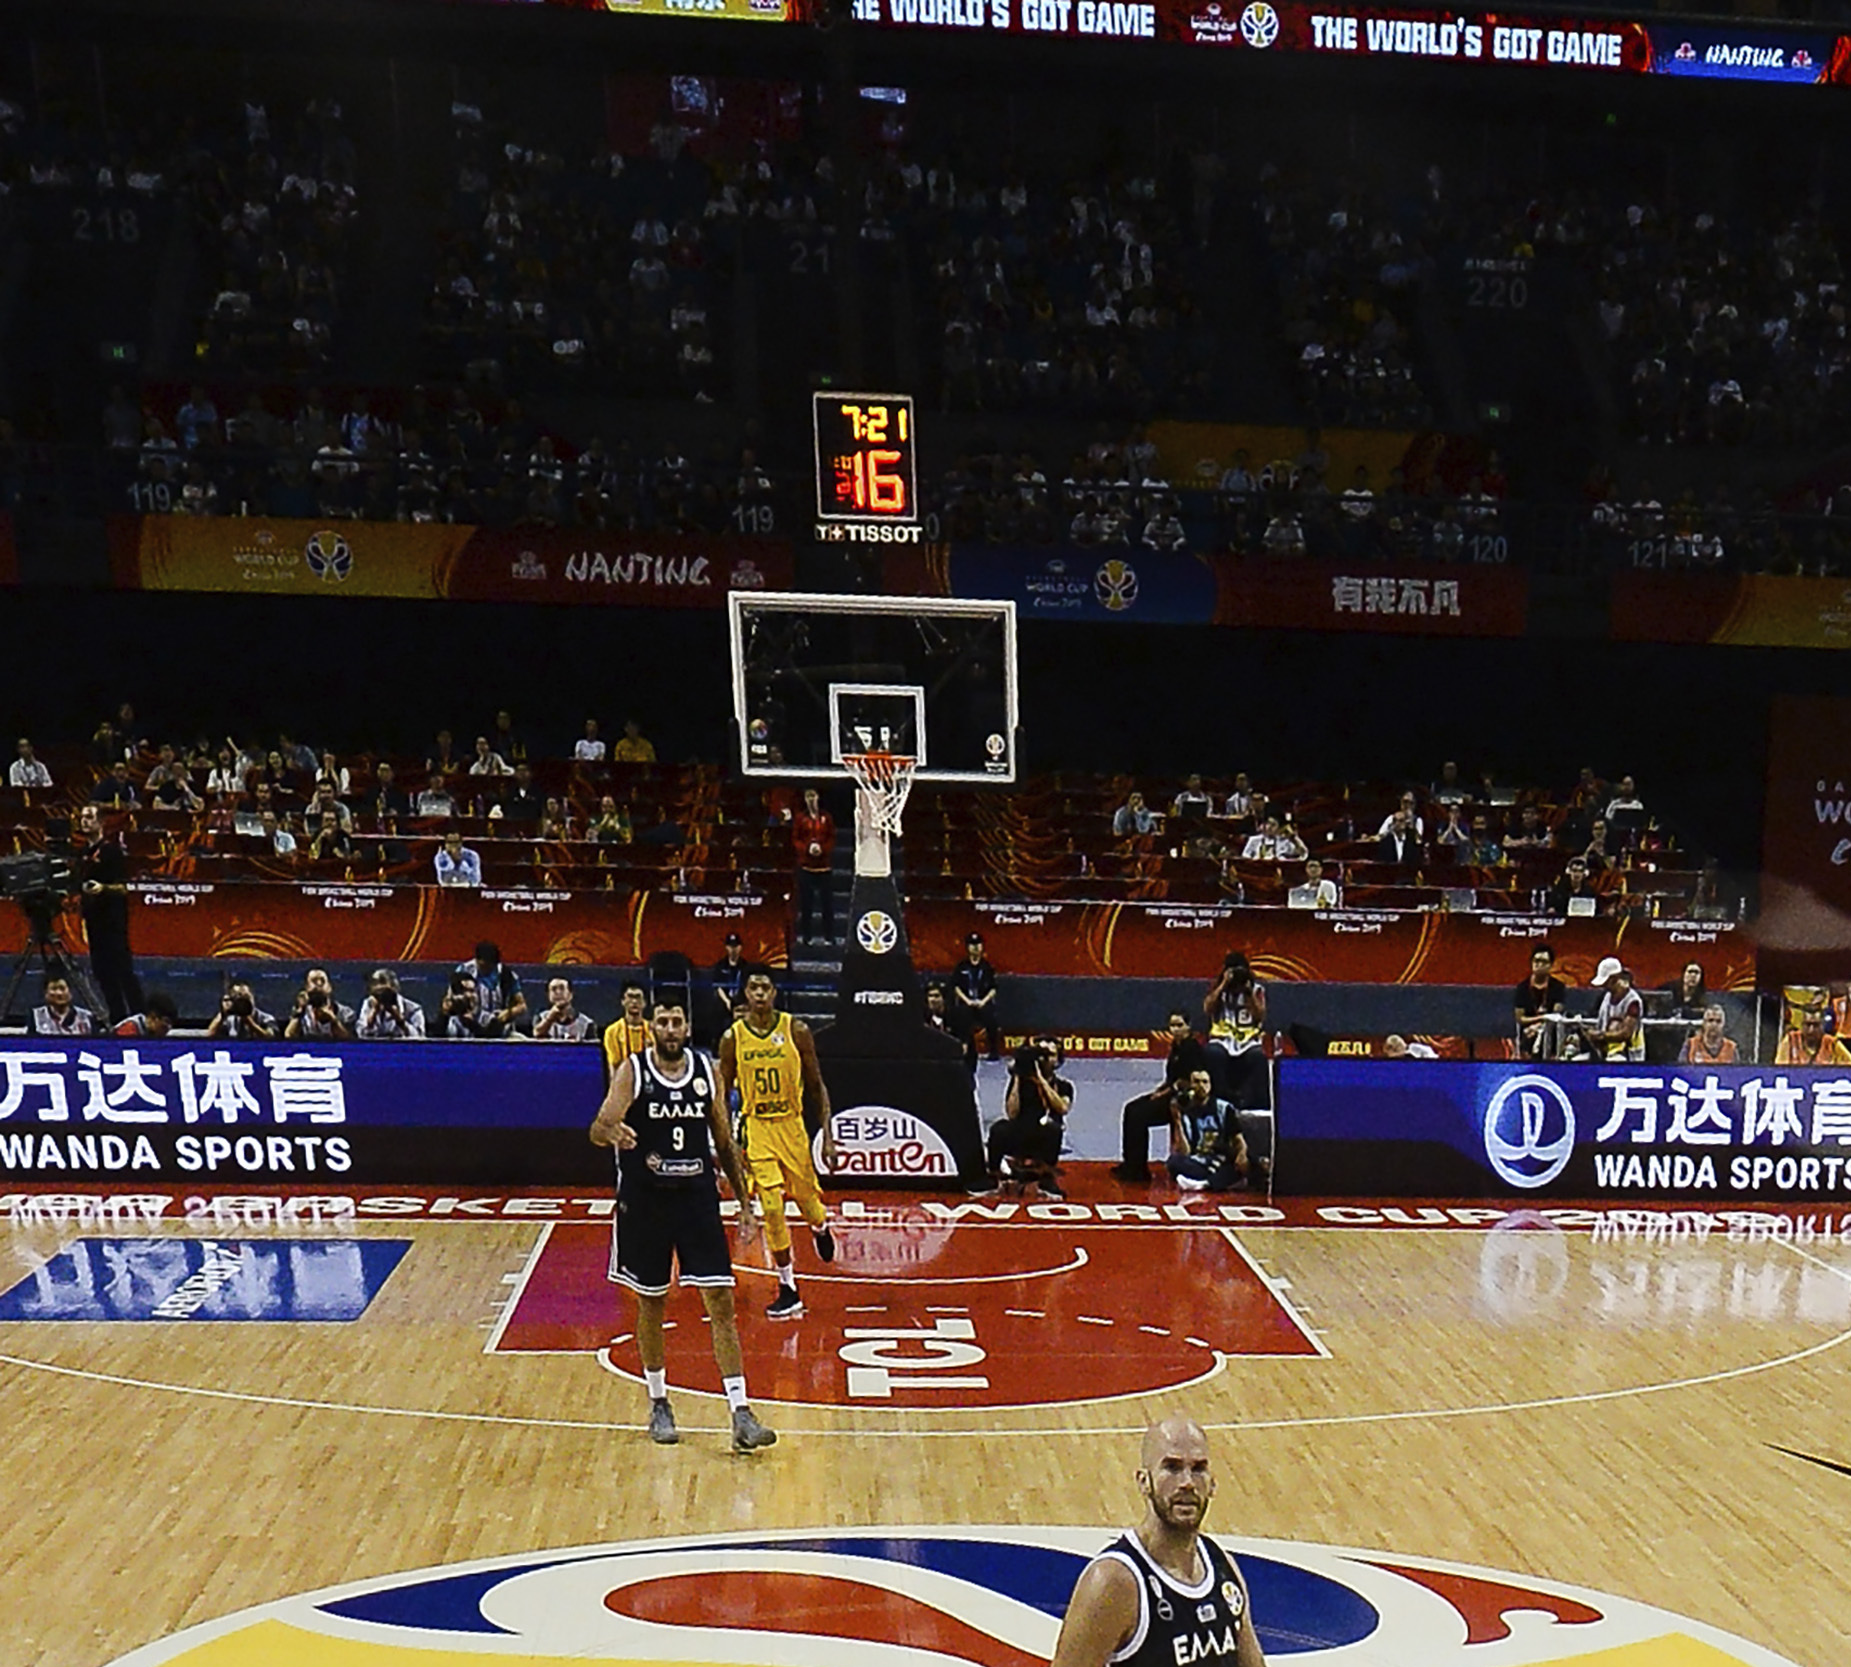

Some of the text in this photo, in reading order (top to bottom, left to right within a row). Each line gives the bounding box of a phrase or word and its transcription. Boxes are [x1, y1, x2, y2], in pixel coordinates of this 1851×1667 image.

[1021, 0, 1069, 32] GOT
[1078, 1, 1155, 38] GAME
[1311, 15, 1622, 66] THE WORLD'S GOT GAME
[841, 404, 908, 442] 7:21
[853, 449, 905, 512] 16
[126, 482, 171, 512] 119
[731, 503, 775, 534] 119
[845, 525, 923, 543] TISSOT
[1468, 534, 1509, 563] 120
[1628, 539, 1667, 569] 121
[1331, 575, 1462, 618] 有我不凡
[0, 1049, 347, 1124] 万达体育
[754, 1067, 781, 1096] 50
[672, 1126, 684, 1151] 9
[836, 1116, 918, 1141] 百岁山
[0, 1134, 352, 1172] WANDA SPORTS
[1593, 1153, 1718, 1190] WANDA
[920, 1200, 1286, 1223] WORLD
